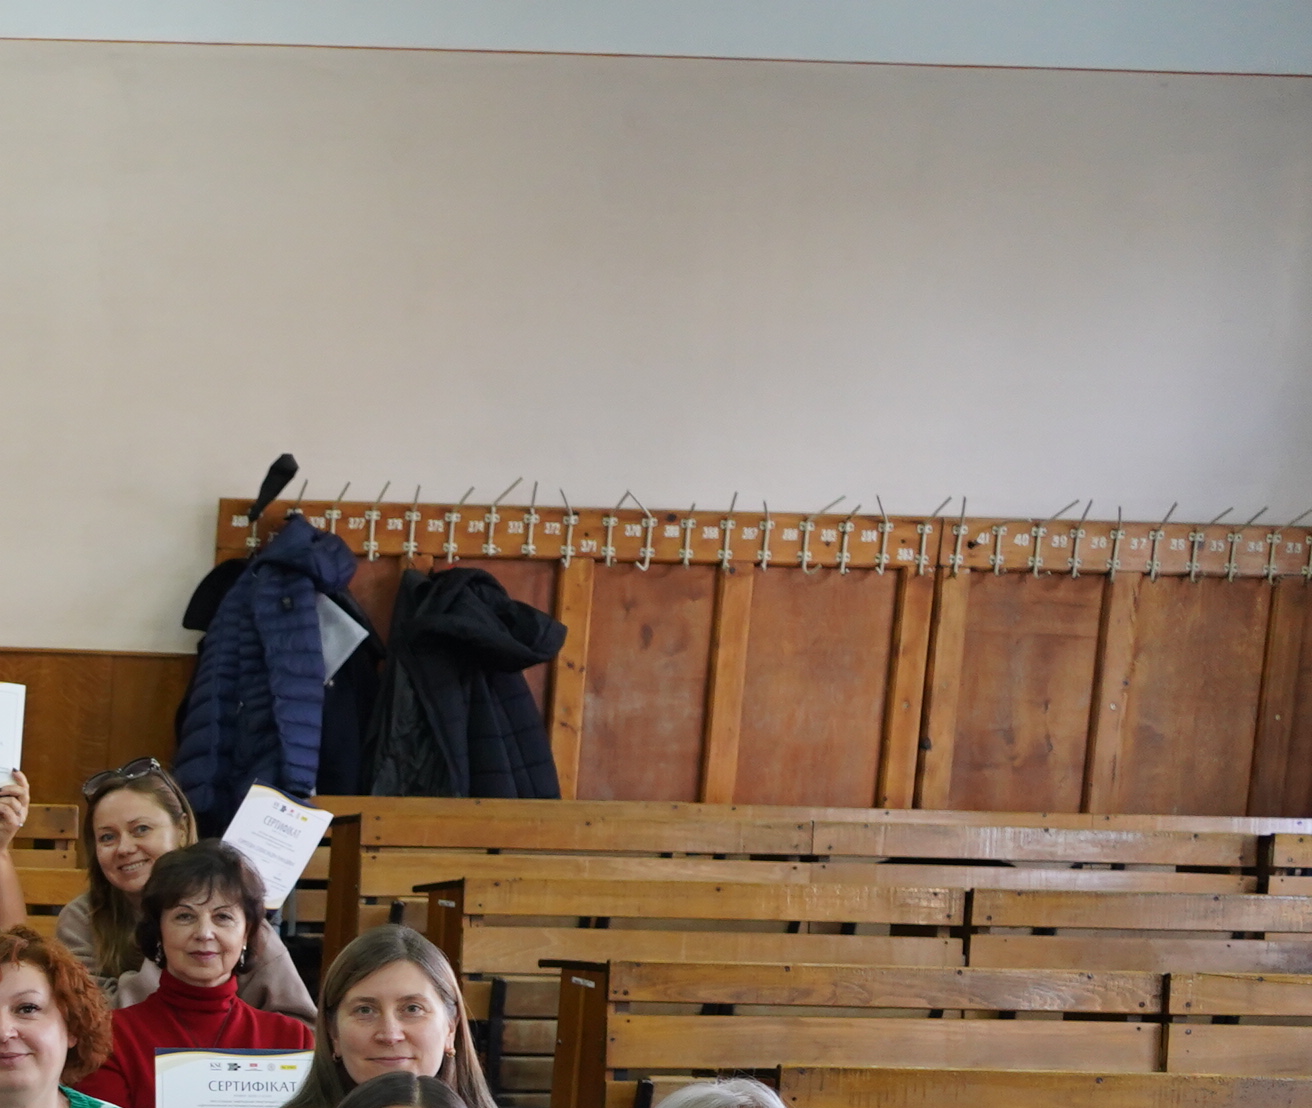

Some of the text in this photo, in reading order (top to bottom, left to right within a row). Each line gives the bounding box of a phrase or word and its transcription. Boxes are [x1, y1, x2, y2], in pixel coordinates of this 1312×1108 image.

[348, 518, 366, 530] 377
[387, 518, 403, 530] 376
[427, 519, 444, 532] 375
[468, 520, 484, 533] 374
[508, 521, 523, 533] 373
[544, 522, 561, 535] 372
[624, 524, 642, 537] 370
[977, 532, 989, 544] 41
[1014, 533, 1029, 546] 40
[1051, 535, 1068, 547] 39
[1130, 538, 1146, 550] 37
[581, 539, 597, 552] 371
[1247, 541, 1263, 552] 34
[1286, 542, 1302, 553] 33
[208, 1080, 296, 1092] СЕРТИФІКАТ
